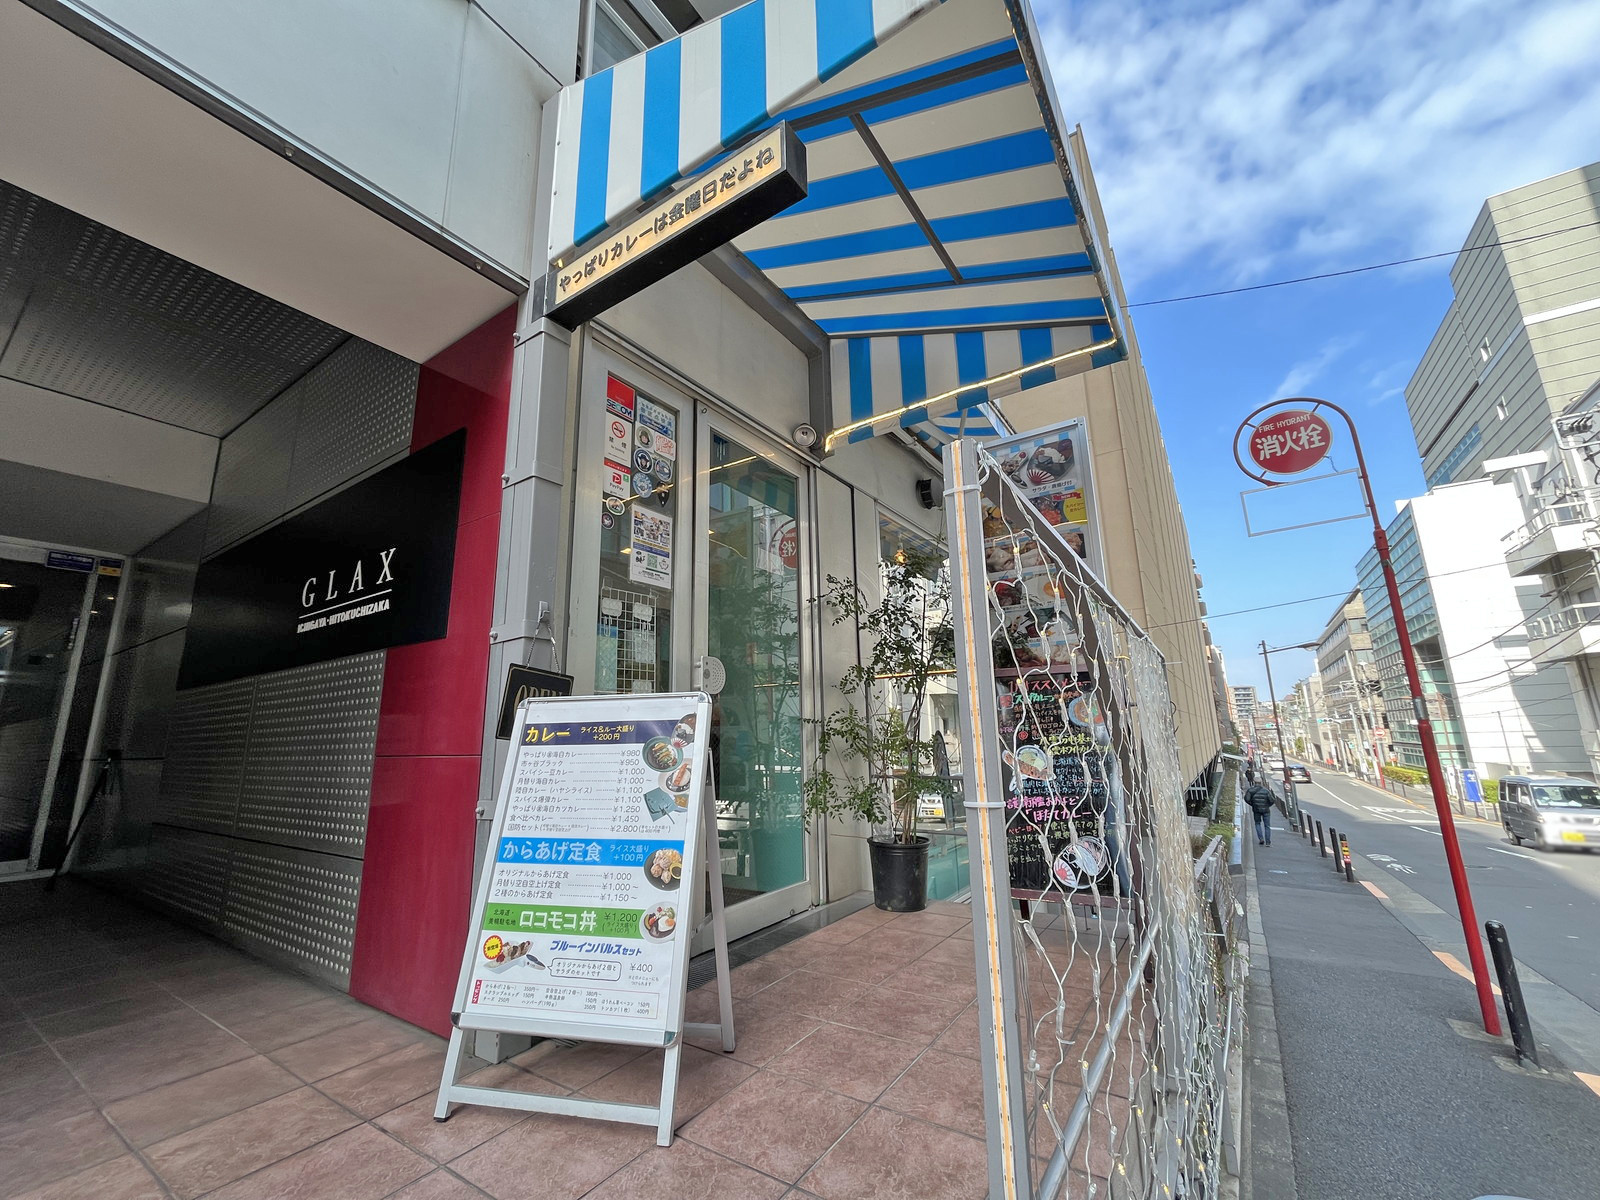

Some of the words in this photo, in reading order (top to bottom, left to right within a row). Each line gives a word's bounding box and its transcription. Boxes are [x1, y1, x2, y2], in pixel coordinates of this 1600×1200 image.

[559, 147, 775, 292] やっぱりカレーは金曜日だよね
[607, 399, 632, 417] SECOM
[1258, 424, 1275, 433] FIRE
[1276, 413, 1311, 429] HYDRANT
[1255, 423, 1325, 460] 消火栓
[609, 482, 624, 492] PayPay
[302, 547, 397, 608] GLAX
[525, 726, 571, 743] カレー
[593, 733, 620, 741] +200円
[519, 768, 574, 776] スパイシー豆カレー
[618, 767, 646, 775] ¥1,000
[616, 786, 644, 794] ¥1,100
[613, 805, 641, 813] ¥1,250
[612, 815, 640, 823] ¥1,450
[610, 825, 638, 833] ¥2,800
[502, 840, 602, 862] からあげ定食
[610, 844, 650, 853] ライス大盛り
[613, 853, 644, 862] +100円
[498, 869, 570, 879] オリジナルからあげ定食
[602, 872, 632, 881] ¥1,000
[519, 910, 597, 932] ロコモコ丼
[604, 911, 638, 922] ¥1,200
[550, 940, 642, 956] ブルーインパルスセット
[629, 963, 653, 972] ¥400
